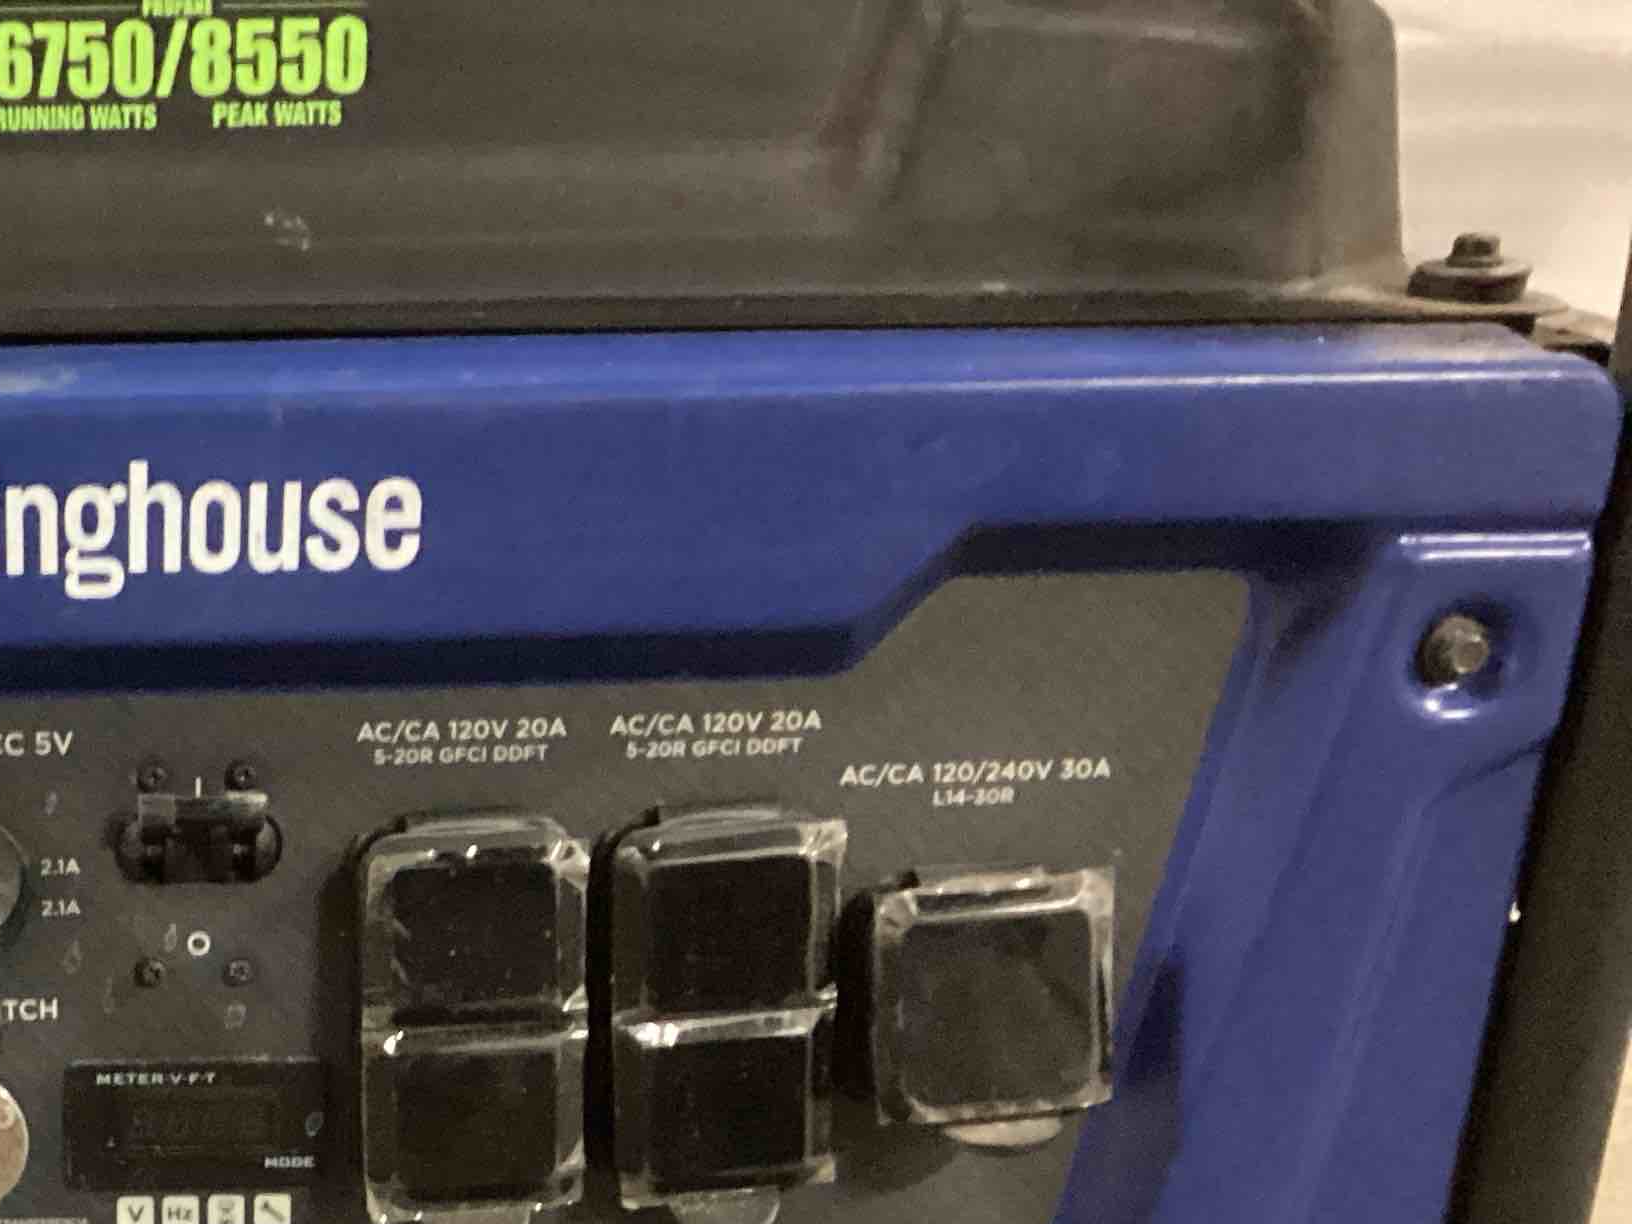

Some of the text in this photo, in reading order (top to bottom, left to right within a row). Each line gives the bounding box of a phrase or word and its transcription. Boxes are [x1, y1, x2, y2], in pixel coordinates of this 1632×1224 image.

[90, 102, 158, 131] WATTS
[212, 99, 343, 128] PEAK WATTS
[356, 716, 568, 744] AC/CA 120V 20A
[609, 708, 823, 737] AC/CA 120V 20A
[34, 730, 74, 756] 5V
[691, 738, 740, 757] GFCI
[439, 746, 488, 764] GFCI
[838, 756, 1112, 787] AC/CA 120/240V 30A
[40, 856, 81, 876] 2.1A
[41, 899, 82, 917] 2.1A
[95, 1071, 165, 1086] METER
[264, 1155, 316, 1169] MODE
[127, 1204, 146, 1223] V
[167, 1206, 193, 1222] Hz
